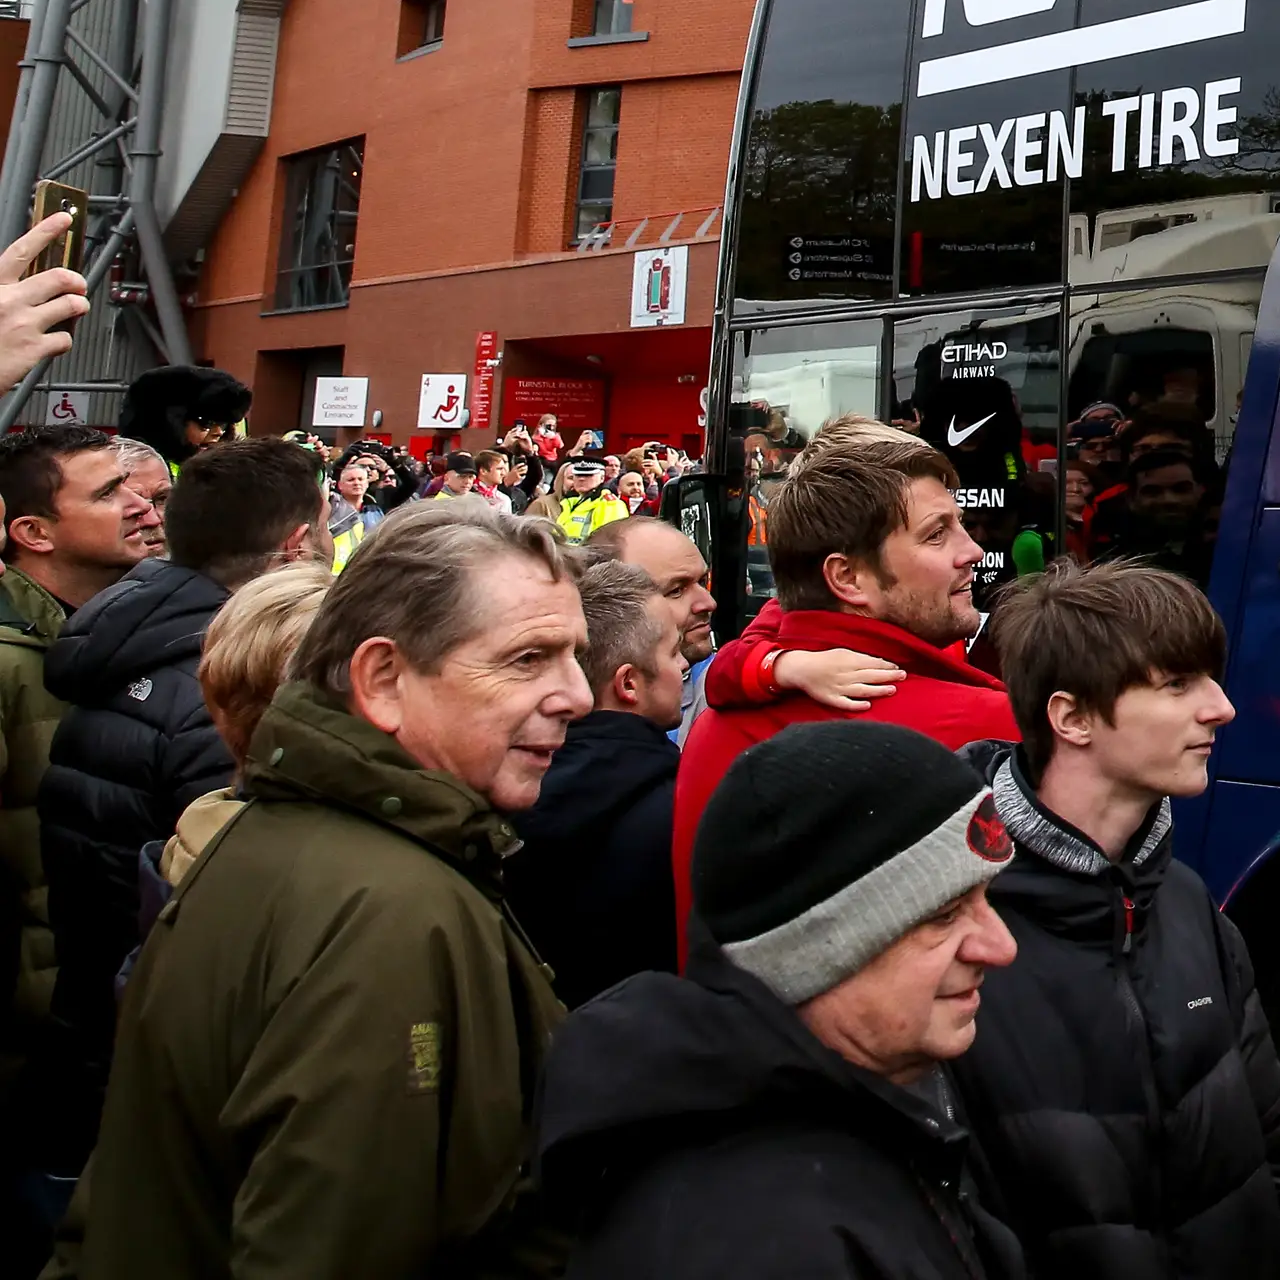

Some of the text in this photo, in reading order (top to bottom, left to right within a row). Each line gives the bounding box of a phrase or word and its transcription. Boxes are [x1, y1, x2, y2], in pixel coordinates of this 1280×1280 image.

[911, 76, 1242, 203] NEXEN TIRE
[941, 341, 1007, 363] ETIHAD
[952, 365, 995, 379] AIRWAYS
[424, 377, 430, 387] 4
[518, 380, 556, 388] TURNSTILE
[333, 385, 349, 393] Staff
[324, 411, 354, 419] Entrance
[948, 488, 1005, 508] SSAN
